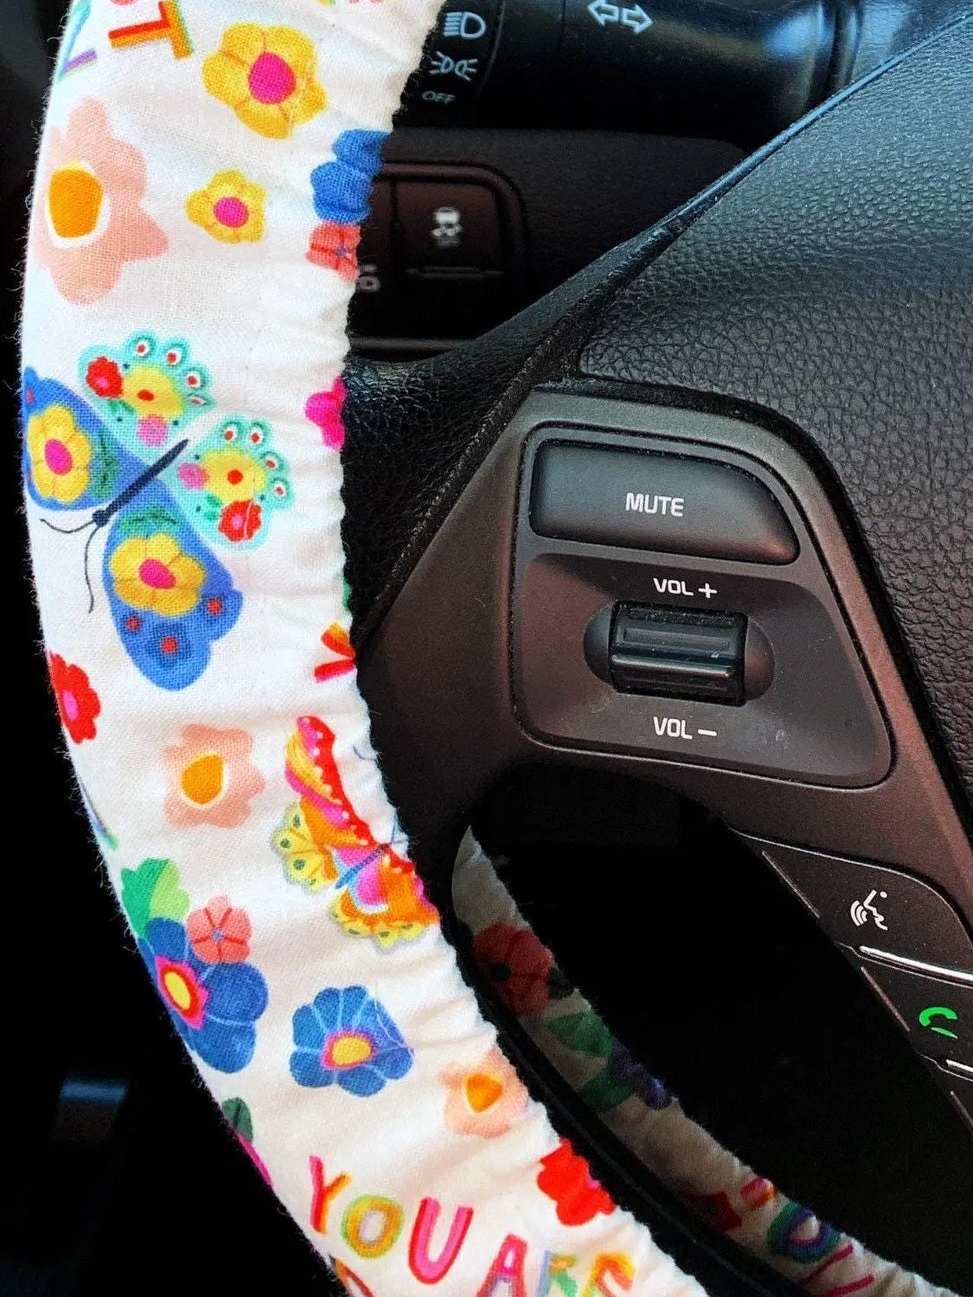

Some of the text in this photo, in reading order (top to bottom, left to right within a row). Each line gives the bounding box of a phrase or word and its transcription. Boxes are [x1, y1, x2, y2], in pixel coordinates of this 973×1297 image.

[421, 89, 457, 105] OFF
[625, 491, 686, 518] MUTE
[652, 576, 694, 597] VOL
[652, 715, 693, 740] VOL
[308, 1154, 475, 1286] YOU
